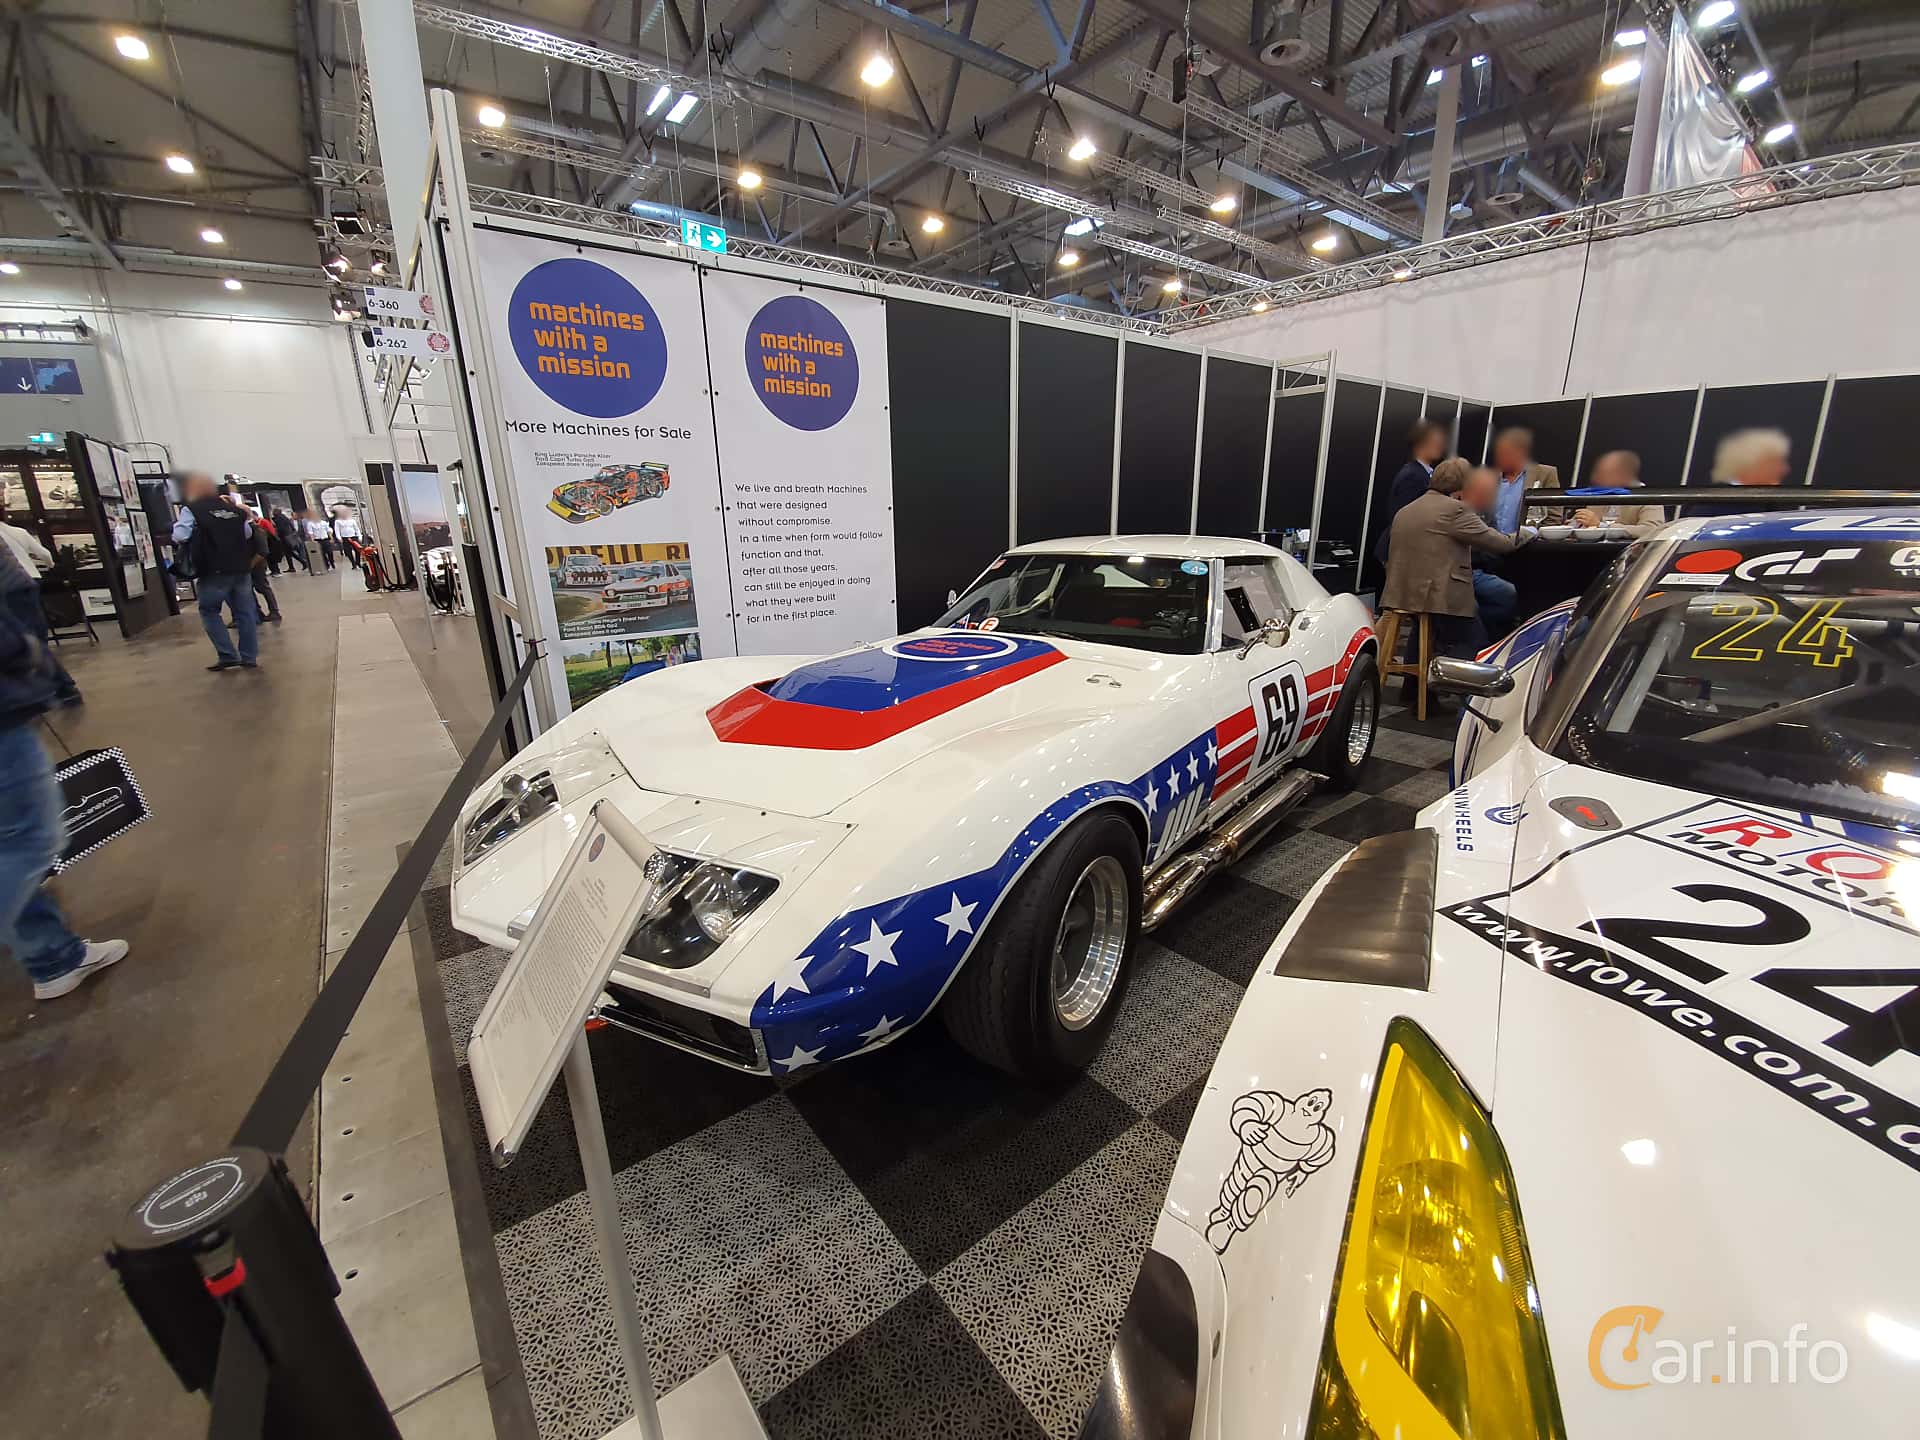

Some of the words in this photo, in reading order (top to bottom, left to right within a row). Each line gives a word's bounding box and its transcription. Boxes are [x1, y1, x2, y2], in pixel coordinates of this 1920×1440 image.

[368, 298, 399, 311] 6-360
[529, 302, 645, 331] machines
[376, 338, 408, 349] 6-262
[534, 325, 587, 351] with
[592, 335, 608, 352] a
[760, 332, 843, 357] machines
[538, 351, 631, 379] mission
[762, 352, 800, 374] with
[804, 360, 816, 375] a
[764, 374, 831, 398] mission
[505, 420, 547, 433] More
[552, 422, 629, 436] Machines
[634, 425, 655, 439] for
[660, 427, 692, 439] Sale
[735, 484, 751, 493] We
[754, 484, 771, 493] live
[774, 485, 792, 494] and
[795, 485, 824, 494] breath
[827, 485, 868, 494] Machines
[736, 501, 757, 510] that
[760, 502, 782, 510] were
[785, 501, 828, 512] designed
[738, 517, 774, 527] without
[740, 535, 749, 543] In
[762, 534, 782, 542] time
[785, 533, 808, 542] when
[810, 532, 830, 542] form
[833, 531, 857, 540] would
[859, 531, 883, 541] follow
[741, 550, 782, 561] function
[784, 549, 802, 558] and
[742, 566, 765, 577] after
[768, 566, 781, 575] all
[783, 566, 808, 574] those
[744, 584, 762, 592] can
[765, 581, 782, 590] still
[785, 581, 796, 590] be
[799, 578, 835, 589] enjoyed
[837, 577, 845, 586] in
[847, 575, 871, 586] doing
[745, 598, 768, 607] what
[770, 597, 792, 607] they
[794, 596, 814, 604] were
[816, 593, 836, 602] built
[747, 614, 760, 625] for
[763, 614, 771, 622] in
[774, 612, 789, 621] the
[791, 611, 808, 622] first
[1690, 595, 1854, 668] 24
[1256, 673, 1300, 769] 69
[1576, 883, 1920, 1067] 24
